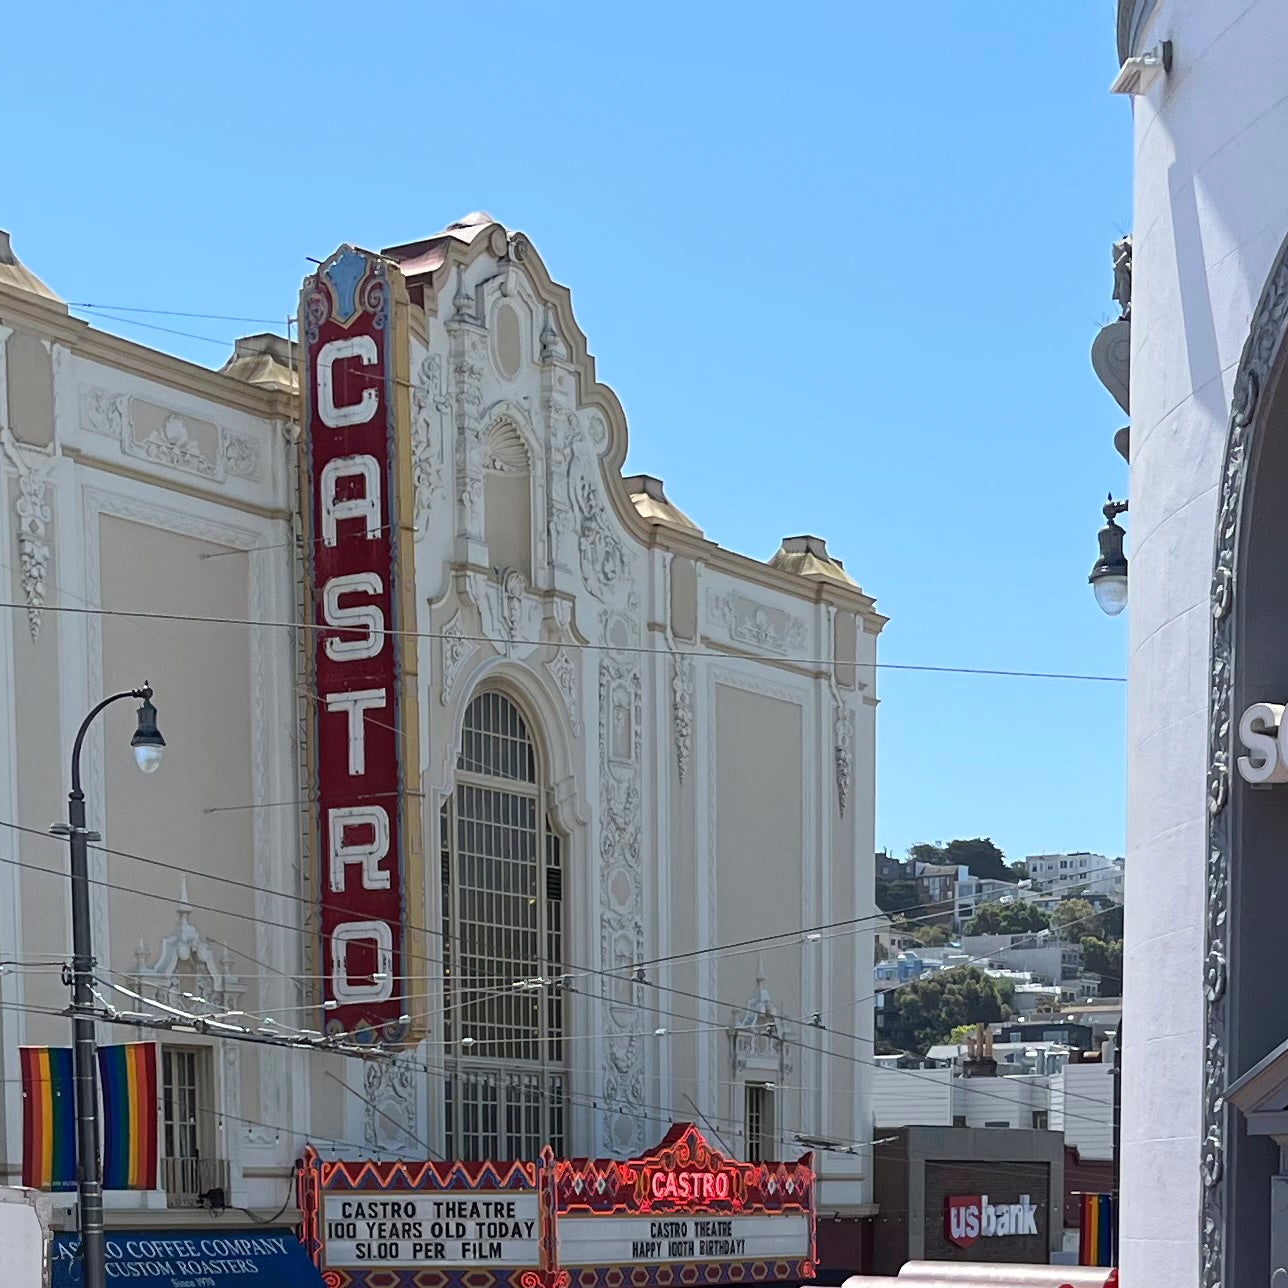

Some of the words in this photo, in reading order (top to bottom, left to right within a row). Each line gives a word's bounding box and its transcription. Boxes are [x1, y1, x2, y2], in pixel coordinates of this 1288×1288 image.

[316, 335, 393, 1005] CASTRO
[652, 1172, 729, 1198] CASTRO
[342, 1201, 416, 1219] CASTRO
[433, 1201, 516, 1219] THEATRE
[328, 1222, 357, 1239] 100
[366, 1222, 423, 1239] YEARS
[430, 1222, 466, 1239] OLD
[476, 1221, 535, 1239] TODAY
[650, 1222, 688, 1238] CASTRO
[694, 1221, 732, 1237] THEATRE
[127, 1239, 200, 1260] COFFEE
[201, 1238, 288, 1257] COMPANY
[413, 1242, 446, 1259] PER
[461, 1241, 502, 1259] FILM
[632, 1241, 661, 1258] HAPPY
[668, 1241, 695, 1257] 100TH
[105, 1261, 175, 1277] CUSTOM
[180, 1259, 259, 1276] ROASTERS
